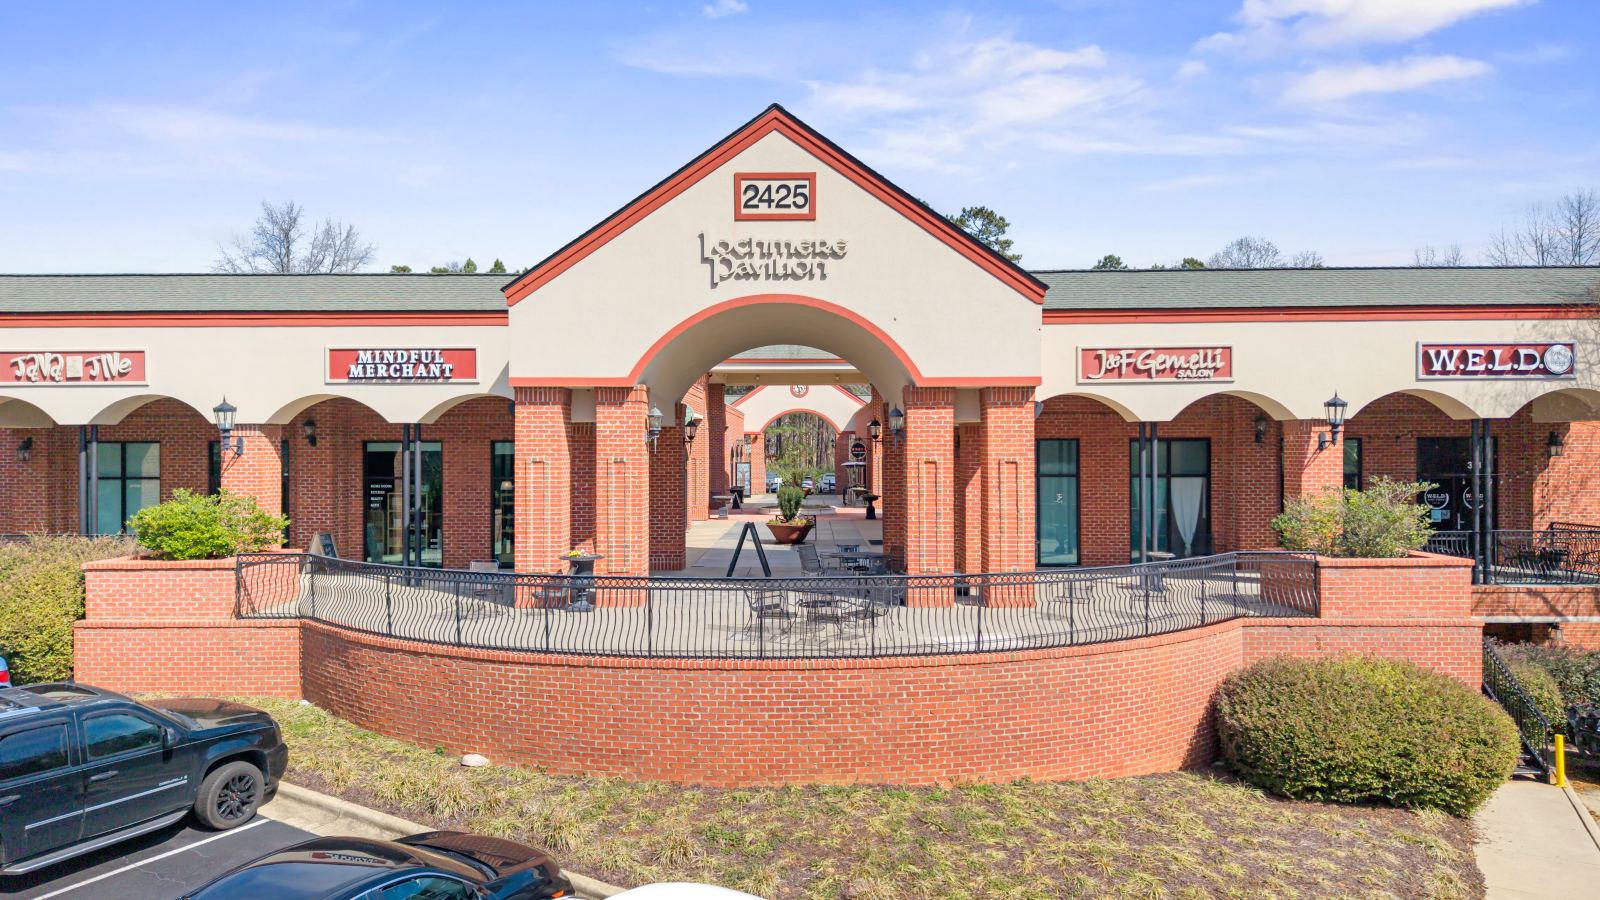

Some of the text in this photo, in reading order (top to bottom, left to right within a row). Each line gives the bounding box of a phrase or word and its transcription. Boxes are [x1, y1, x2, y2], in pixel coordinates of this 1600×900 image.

[743, 184, 808, 209] 2425
[356, 350, 444, 364] MINDFUL
[1136, 348, 1225, 378] Gemelli
[1427, 349, 1544, 371] W.E.L.D.
[348, 364, 453, 378] MERCHANT
[1177, 369, 1215, 378] SALON
[1467, 461, 1482, 469] 31
